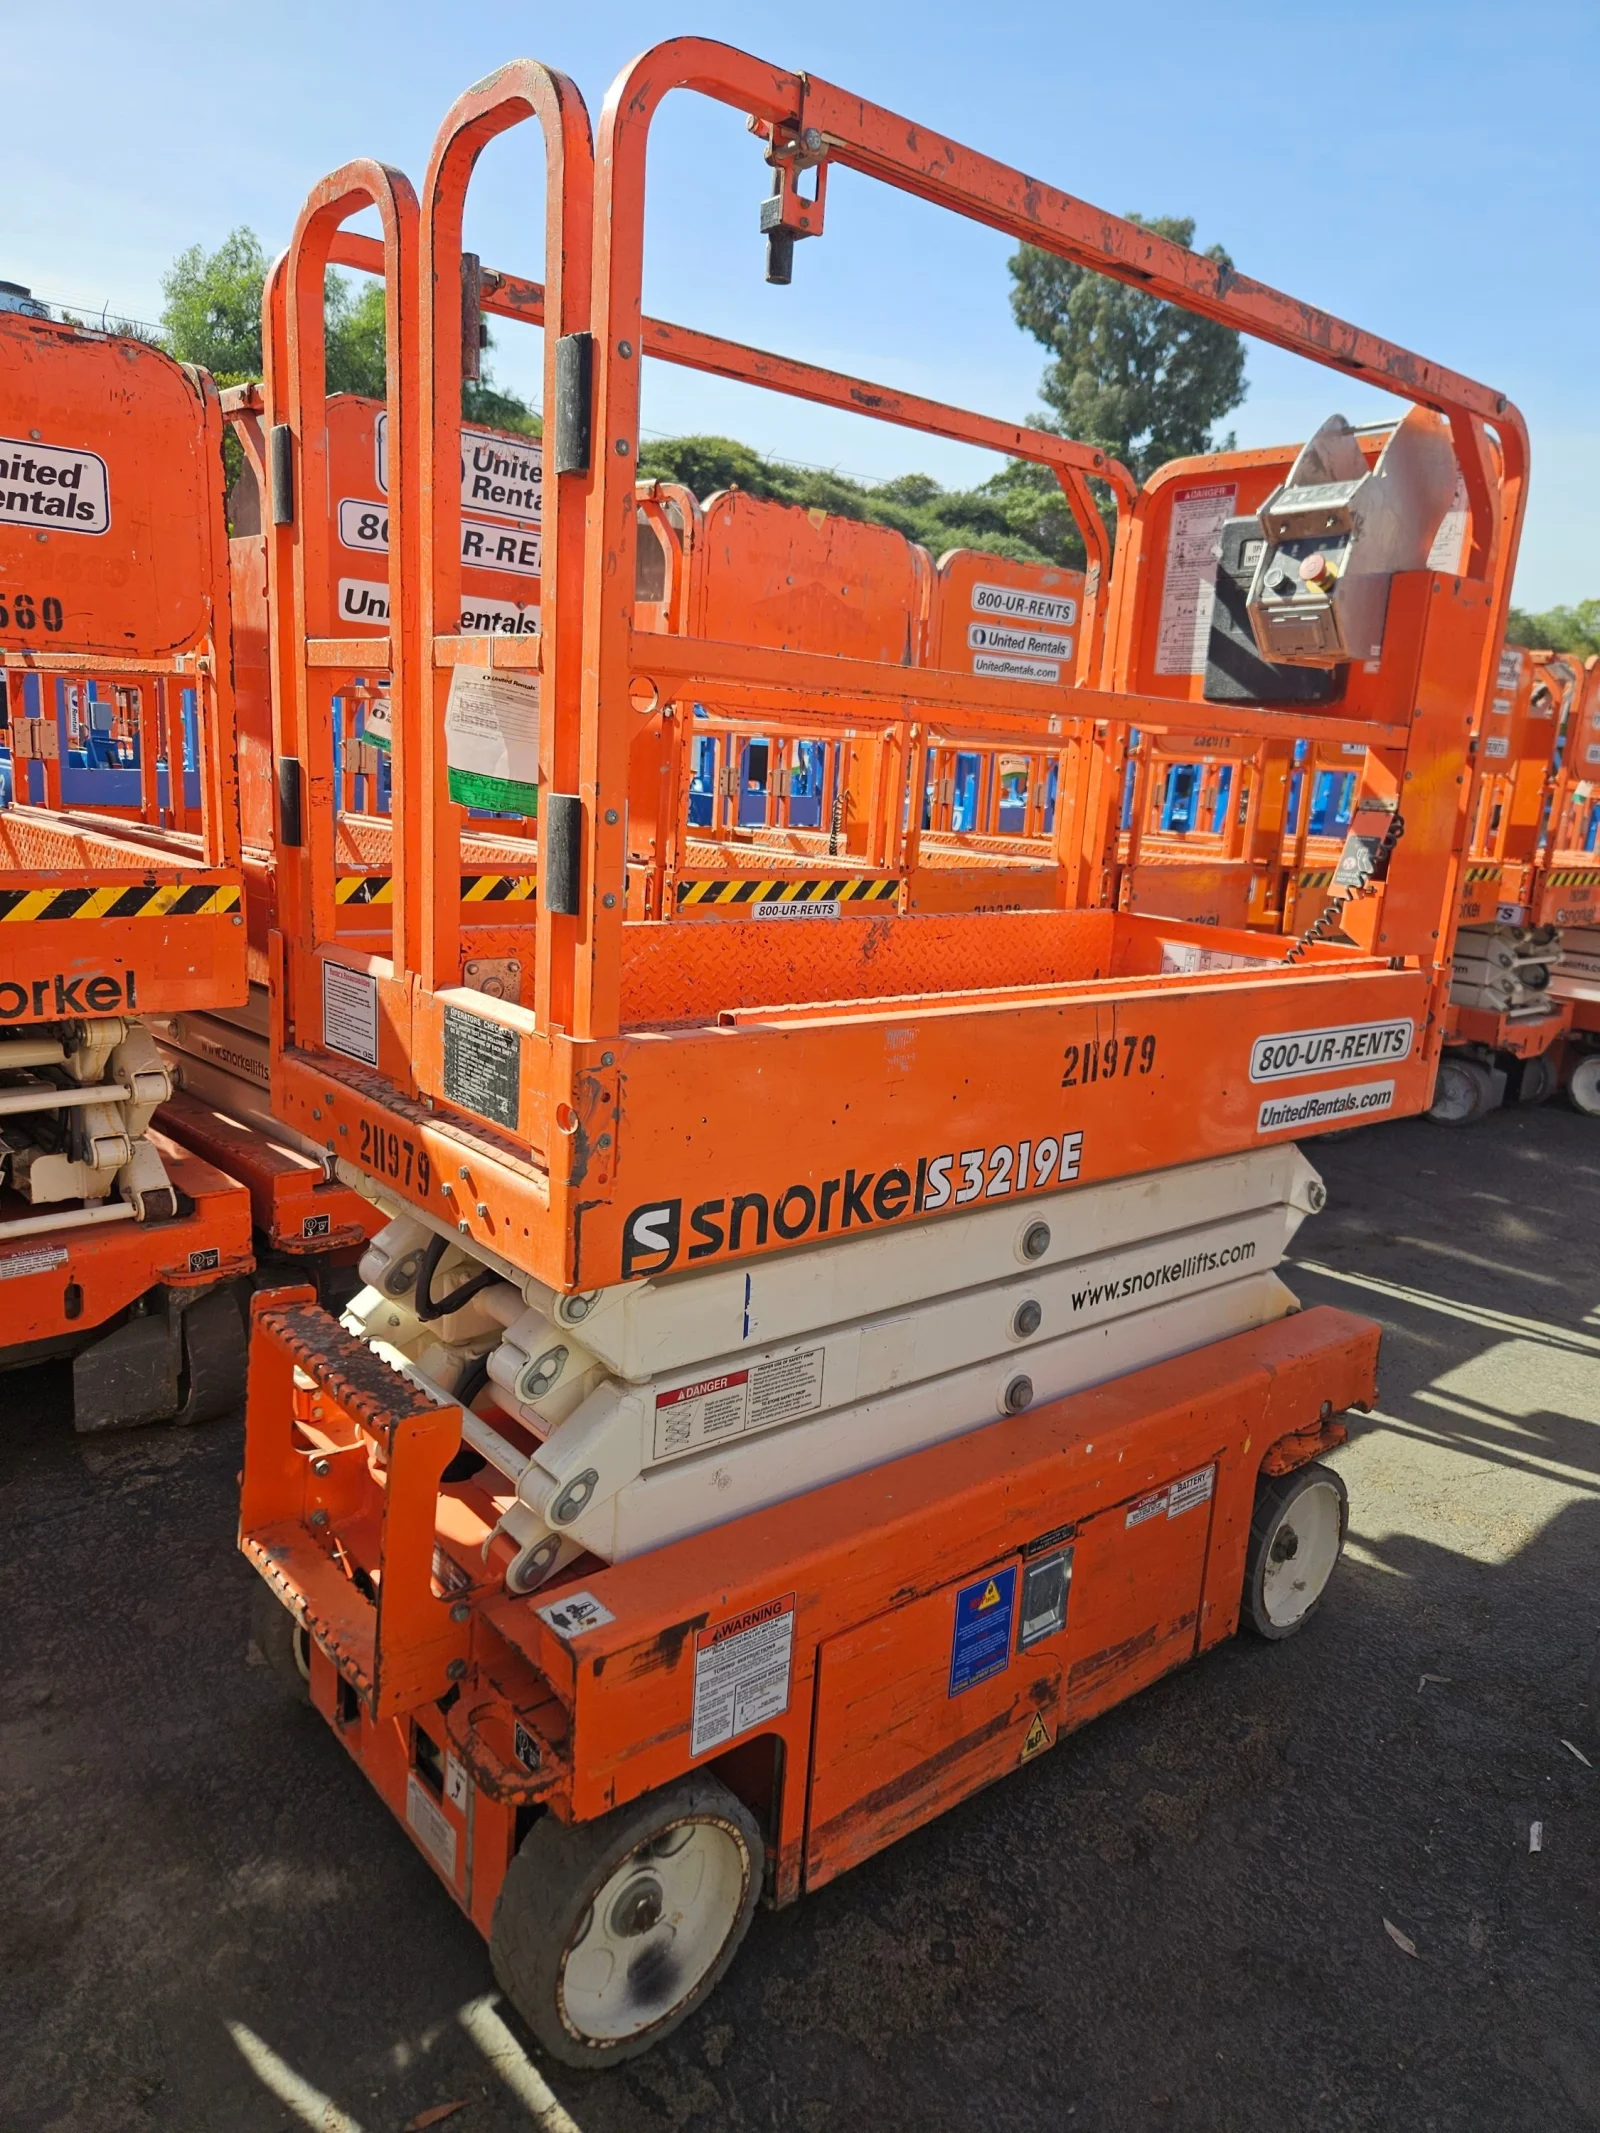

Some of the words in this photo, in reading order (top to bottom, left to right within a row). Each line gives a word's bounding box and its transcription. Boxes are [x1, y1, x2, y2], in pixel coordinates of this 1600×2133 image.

[0, 492, 96, 521] ntals
[977, 591, 1071, 620] 800-UR-RENTS
[988, 631, 1025, 650] United
[1027, 637, 1066, 655] Rentals
[491, 675, 513, 685] United
[513, 680, 537, 690] Rentals
[976, 659, 1057, 678] UnitedRentals.com
[758, 904, 835, 916] 800-UR-RENTS
[1061, 1035, 1156, 1087] 211979
[1258, 1028, 1406, 1072] 800-UR-RENTS
[1261, 1088, 1392, 1128] UnitedRentals.com
[359, 1118, 430, 1197] 211979
[688, 1157, 927, 1260] snorkel
[924, 1130, 1084, 1209] S3219E
[1071, 1241, 1256, 1311] www.snorkellifts.com
[686, 1377, 727, 1398] DANGER
[1177, 1472, 1207, 1493] BATTERY
[722, 1602, 772, 1634] WARNING
